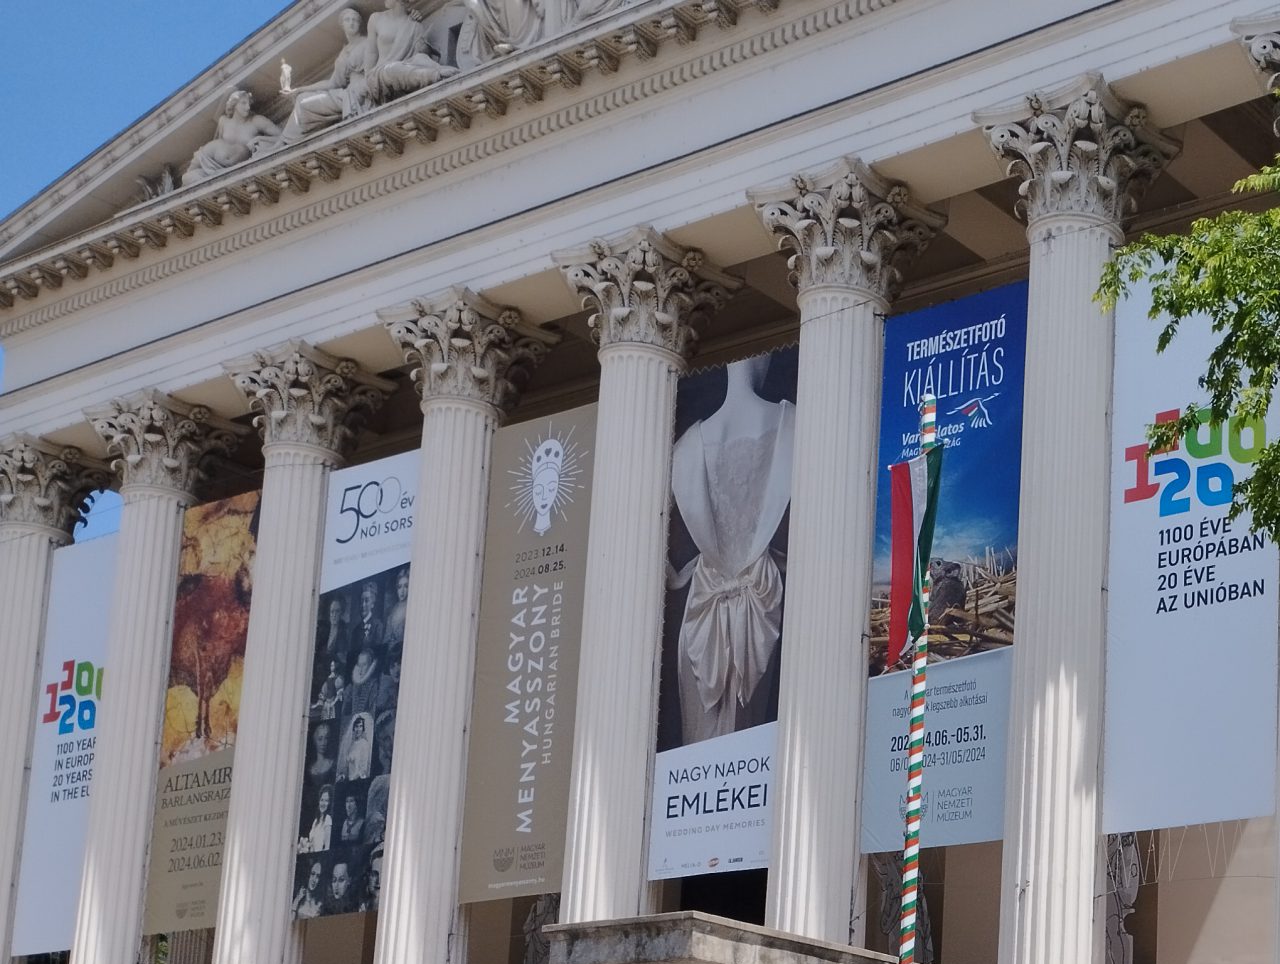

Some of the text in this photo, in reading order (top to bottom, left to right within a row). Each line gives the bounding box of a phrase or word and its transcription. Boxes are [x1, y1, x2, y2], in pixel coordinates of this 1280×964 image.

[907, 313, 1006, 362] TERMÉSZETFOTÓ
[903, 343, 1004, 408] KIÁLLÍTÁS
[902, 422, 965, 446] Varlatos
[1154, 457, 1235, 518] 20
[336, 476, 401, 544] 500
[384, 516, 414, 534] SORS
[1158, 516, 1232, 546] 1100 ÉVE
[1158, 530, 1265, 569] EURÓPÁBAN
[1157, 564, 1216, 592] 20 ÉVE
[1156, 578, 1265, 614] AZ UNIÓBAN
[504, 585, 529, 724] MAGYAR
[541, 580, 564, 765] HUNGARIAN BRIDE
[515, 583, 549, 833] MENYASSZONY
[56, 742, 74, 755] 1100
[890, 724, 986, 752] 2024.06.-05.31.
[54, 753, 95, 772] IN EUROP
[668, 756, 770, 785] NAGY NAPOK
[52, 775, 63, 788] 20
[163, 766, 232, 794] ALTAMIR
[937, 786, 973, 799] MAGYAR
[51, 791, 60, 803] IN
[63, 787, 78, 801] THE
[161, 787, 231, 809] BARLANGRAJZ
[666, 781, 768, 819] EMLÉKEI
[937, 797, 973, 811] NEMZETI
[665, 819, 766, 838] WEDDING DAY MEMORIES
